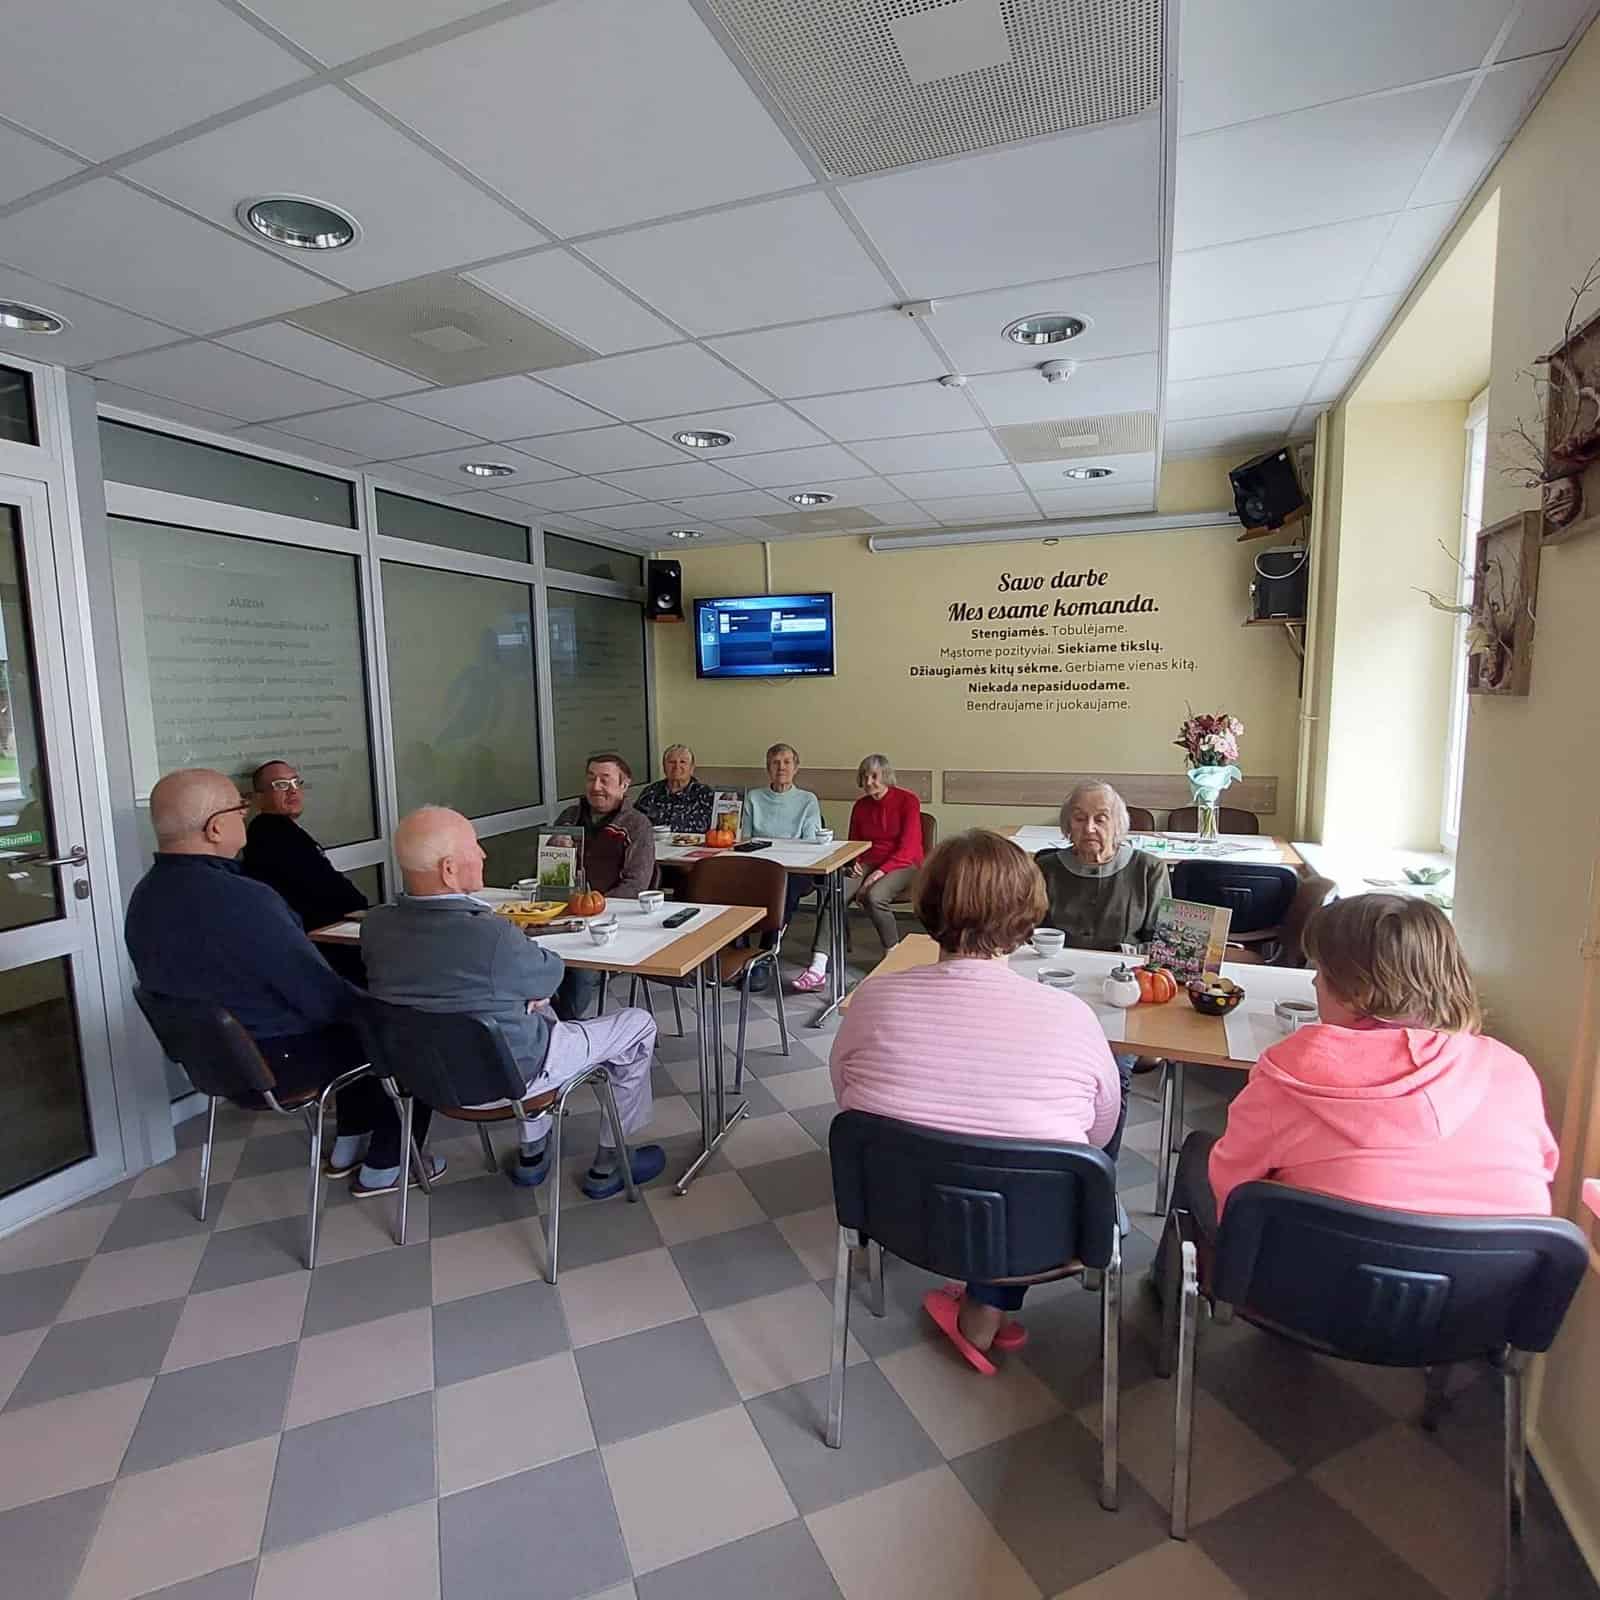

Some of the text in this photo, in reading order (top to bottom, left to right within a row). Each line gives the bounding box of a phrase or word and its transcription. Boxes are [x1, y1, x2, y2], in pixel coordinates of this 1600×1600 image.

[998, 568, 1109, 592] Savo darbe
[948, 594, 1160, 622] Mes esame komanda.
[971, 623, 1127, 640] Stengiamės. Tobulėjame.
[940, 648, 992, 659] Mąstome
[1057, 643, 1118, 655] Siekiame
[1120, 640, 1164, 653] tikslų.
[910, 664, 986, 677] Džiaugiamės
[990, 663, 1014, 677] kitų
[1017, 663, 1062, 674] sėkme.
[1065, 660, 1125, 673] Gerbiame
[1127, 659, 1168, 671] vienas
[968, 680, 1130, 693] Niekada nepasiduodame.
[967, 699, 1131, 712] Bendraujame ir juokaujame.
